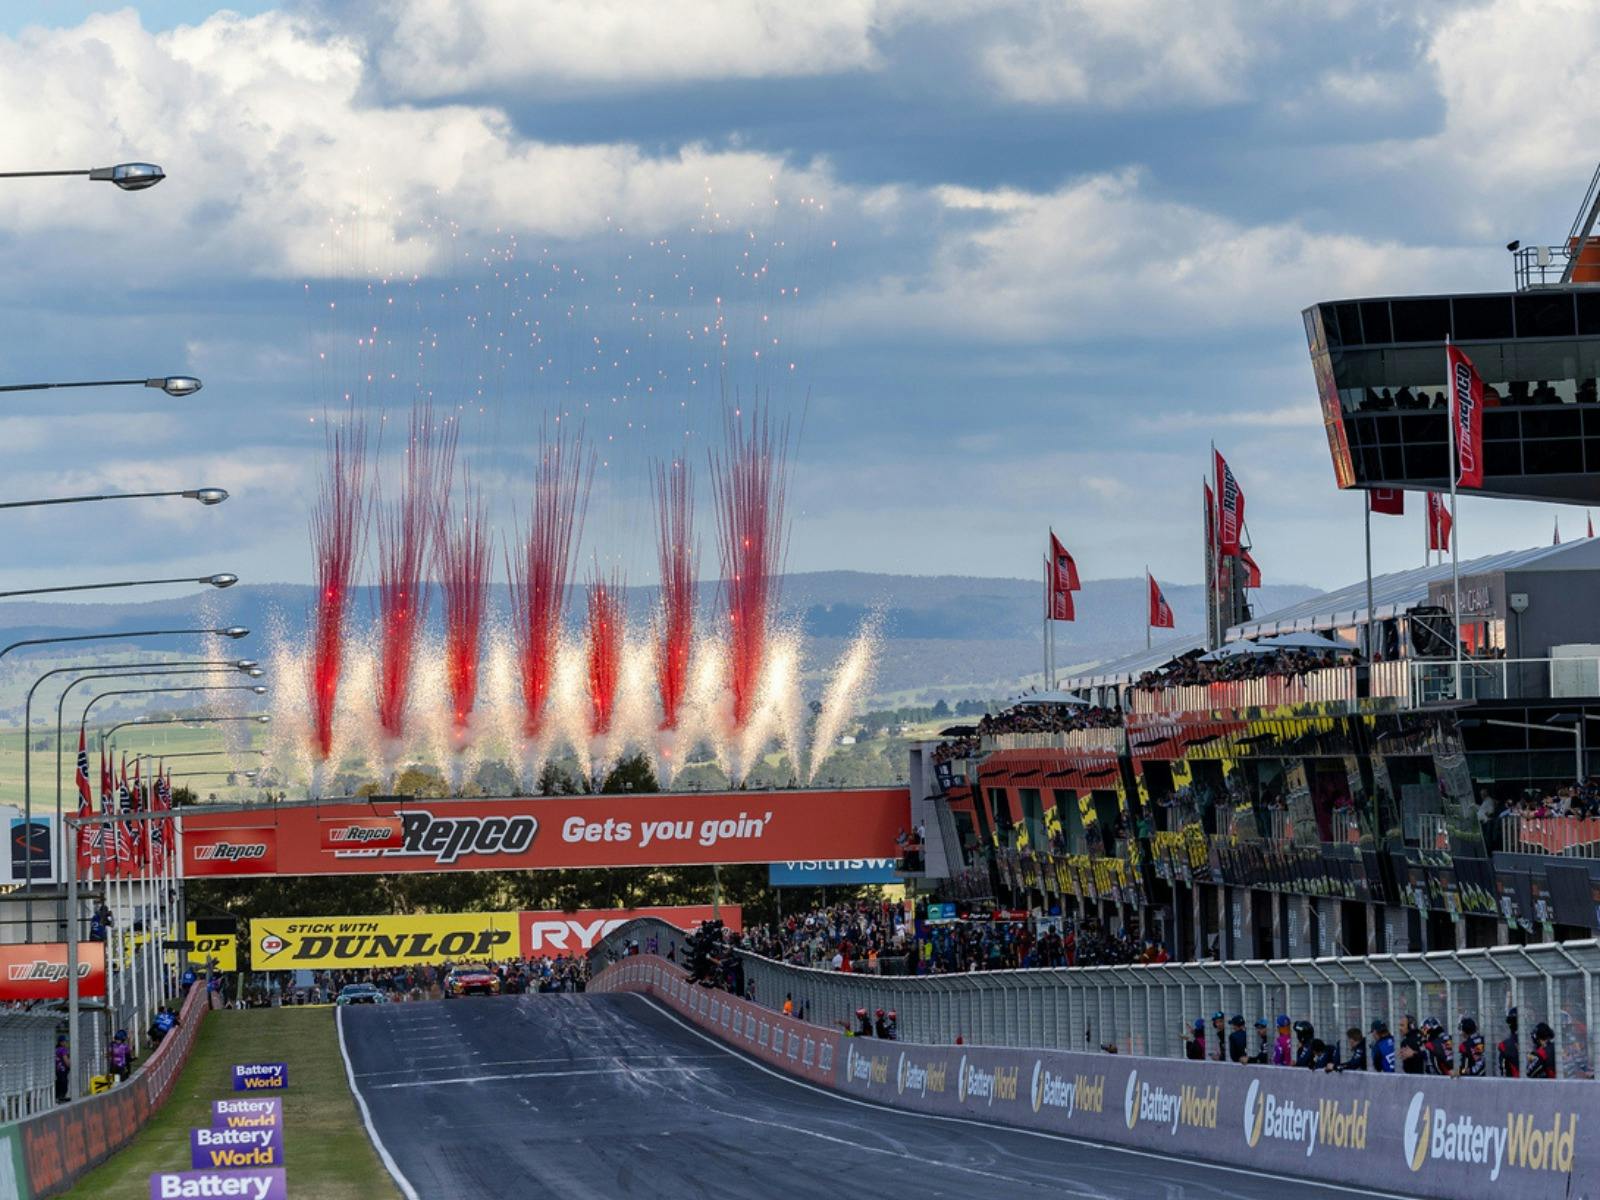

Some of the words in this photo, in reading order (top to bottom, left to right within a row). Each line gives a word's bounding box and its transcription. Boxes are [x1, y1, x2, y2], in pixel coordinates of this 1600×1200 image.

[347, 825, 392, 843] Repco
[397, 811, 538, 863] Repco
[562, 816, 632, 843] Gets
[638, 819, 694, 848] you
[214, 842, 267, 861] Repco
[786, 858, 893, 871] visitnsw.
[286, 923, 335, 934] STICK
[339, 922, 379, 933] WITH
[291, 931, 511, 960] DUNLOP
[31, 960, 91, 982] Repo
[236, 1064, 282, 1076] Battery
[244, 1076, 283, 1088] World
[217, 1101, 275, 1114] Battery
[227, 1114, 276, 1127] World
[197, 1128, 273, 1146] Battery
[210, 1146, 274, 1167] World
[160, 1174, 273, 1200] Battery
